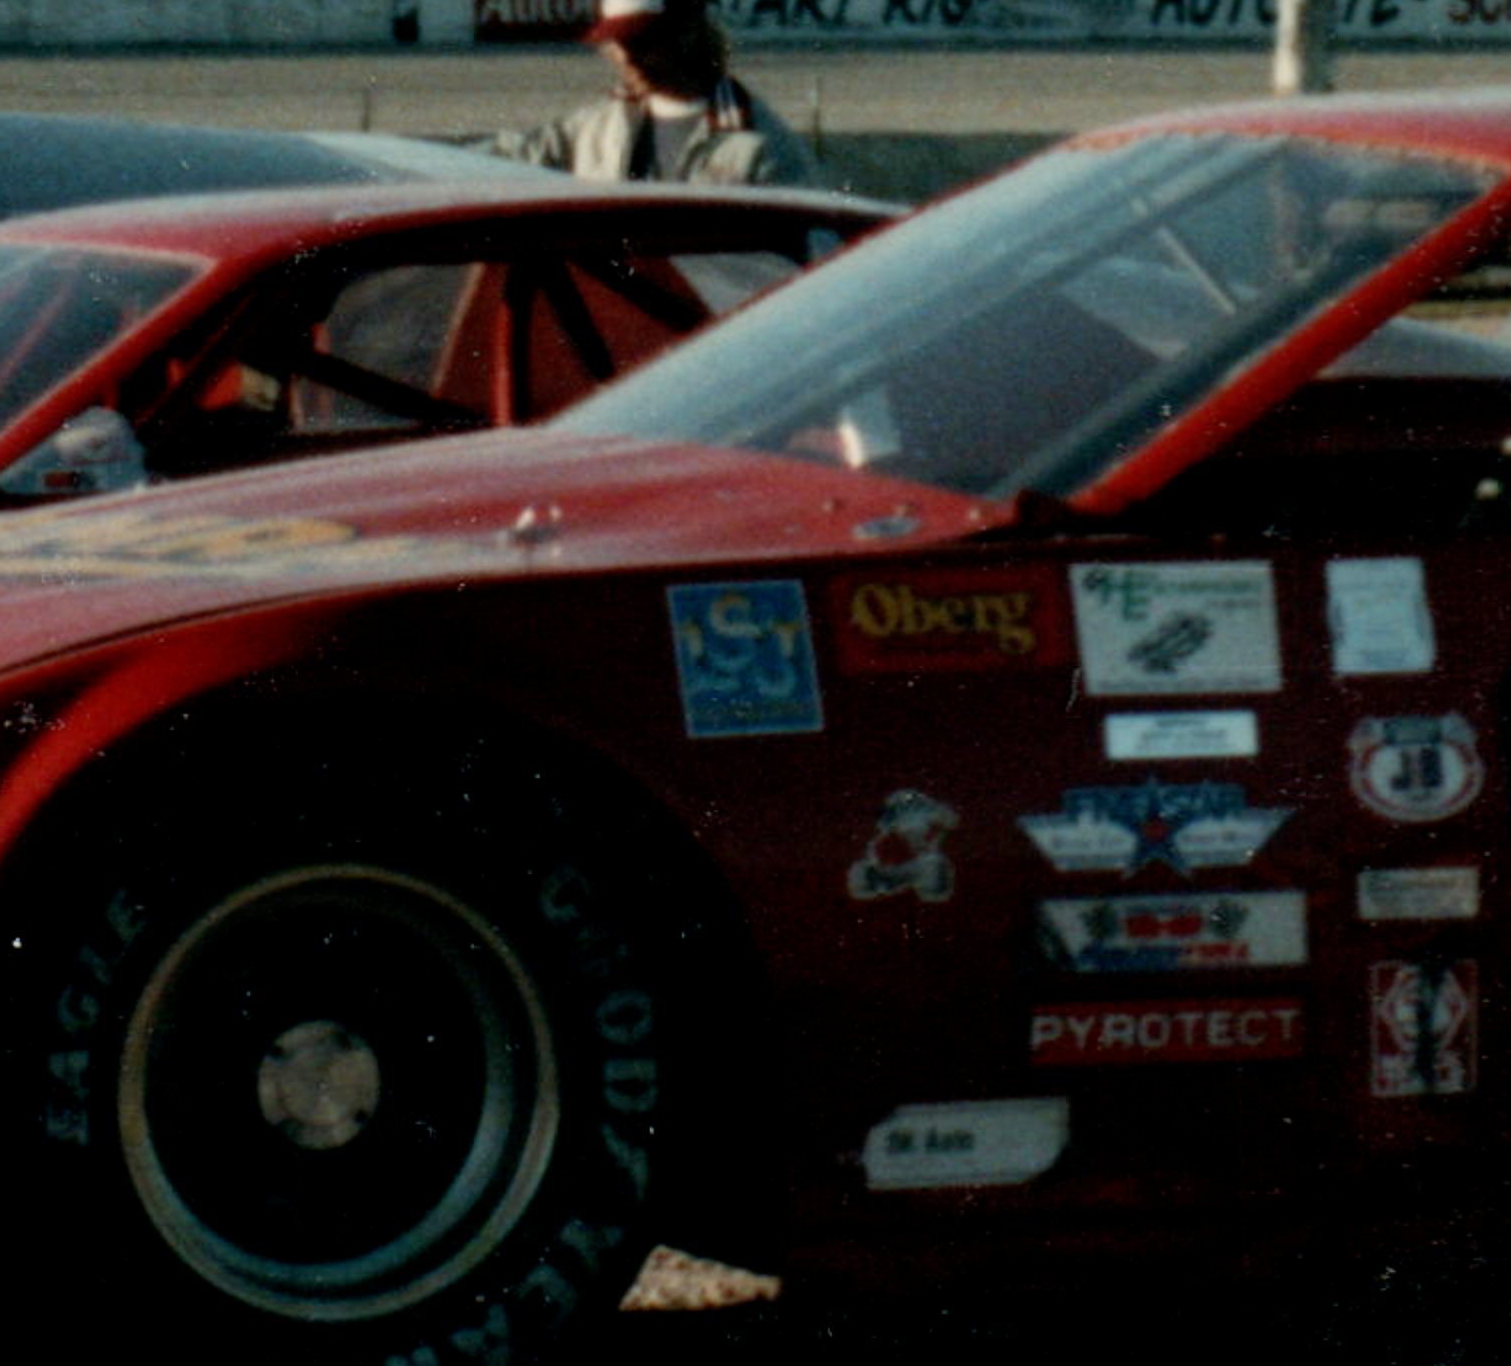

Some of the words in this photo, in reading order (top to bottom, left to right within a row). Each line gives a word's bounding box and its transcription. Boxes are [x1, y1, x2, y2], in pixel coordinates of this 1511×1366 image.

[850, 581, 1037, 656] Oberg
[39, 885, 150, 1149] EAGLE
[1029, 1008, 1302, 1051] PYROTECT
